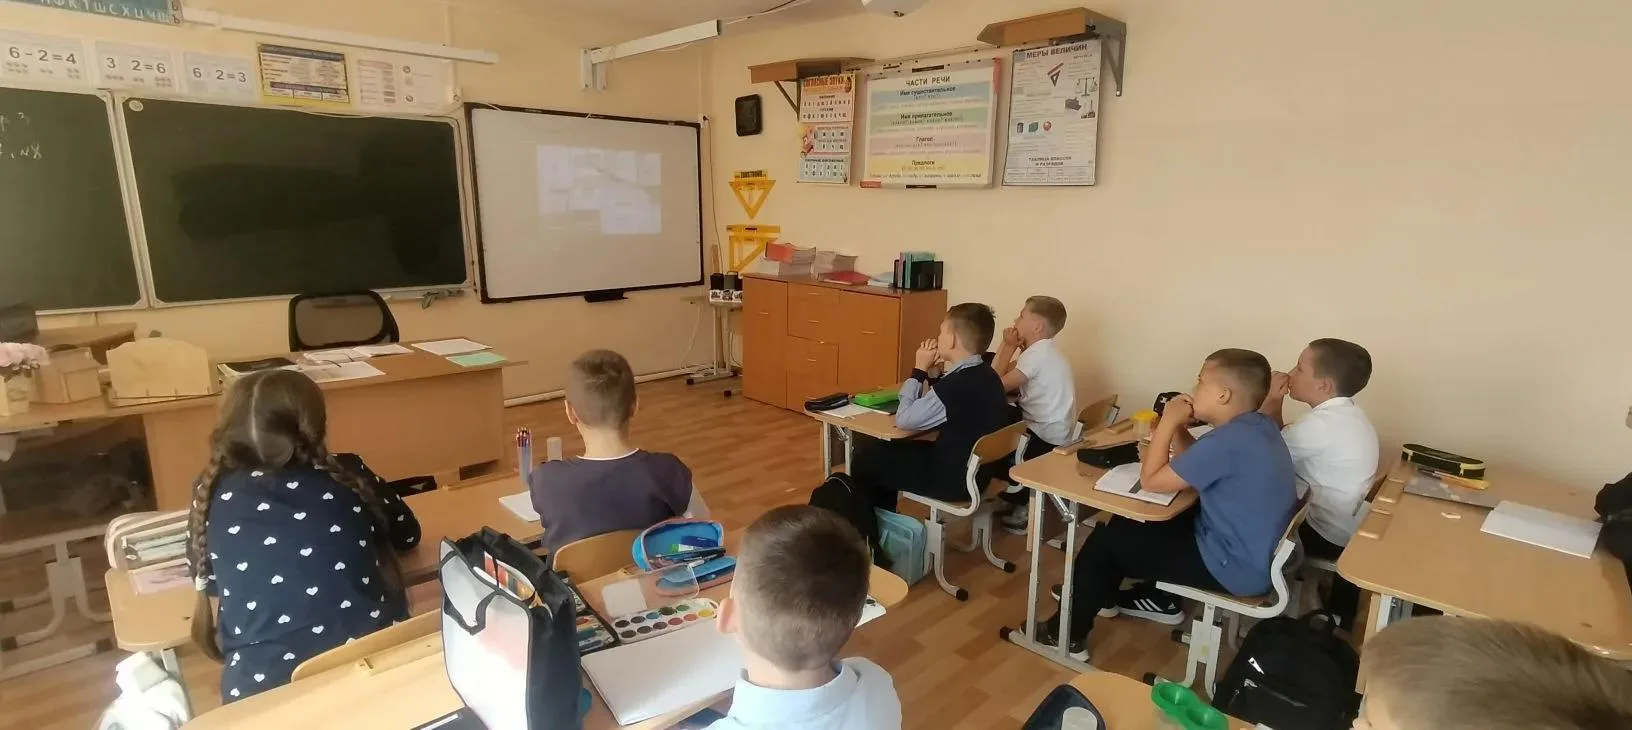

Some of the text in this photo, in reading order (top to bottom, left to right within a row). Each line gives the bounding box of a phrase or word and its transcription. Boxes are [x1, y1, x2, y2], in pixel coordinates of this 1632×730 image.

[1026, 43, 1088, 59] МЕРЫ ВЕЛИЧИН
[106, 57, 117, 69] 3
[192, 67, 202, 79] 6
[906, 76, 951, 87] ЧАСТИ РЕЧИ
